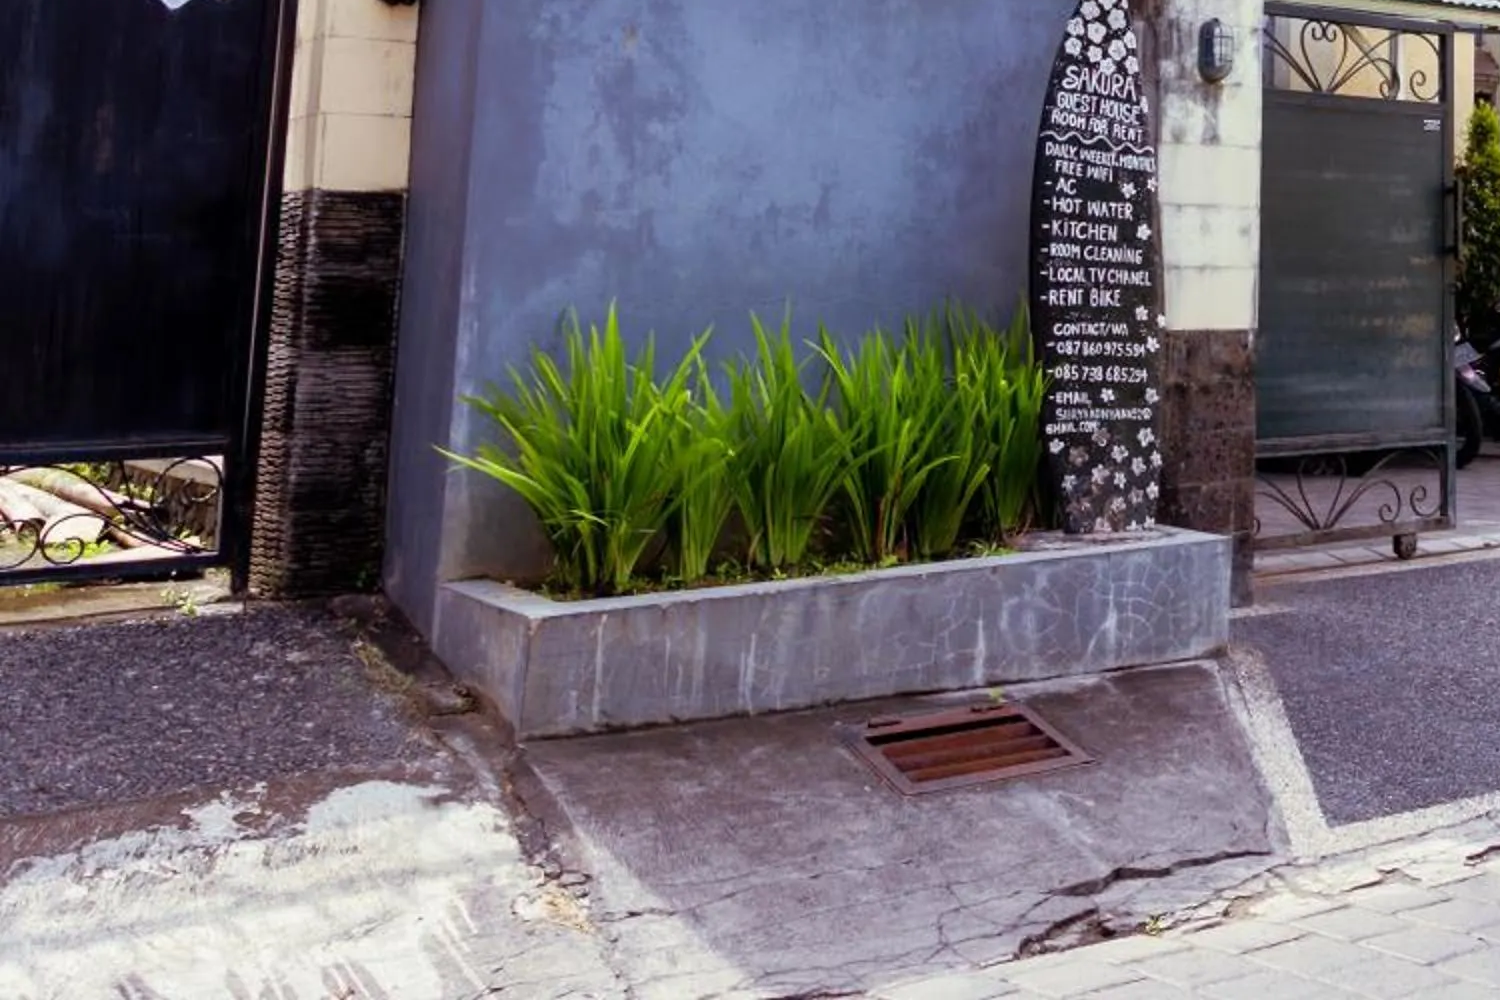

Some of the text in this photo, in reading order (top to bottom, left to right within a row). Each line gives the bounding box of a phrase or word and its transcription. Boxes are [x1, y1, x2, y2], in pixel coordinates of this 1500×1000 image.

[1062, 65, 1136, 102] SAKURA
[1057, 91, 1142, 125] GUEST HOUSE
[1051, 109, 1143, 144] ROOM FOR RENT
[1055, 159, 1084, 177] FREE
[1055, 177, 1077, 195] AC
[1087, 199, 1133, 221] WATER
[1088, 267, 1106, 283] TV
[1089, 285, 1121, 308] BIKE
